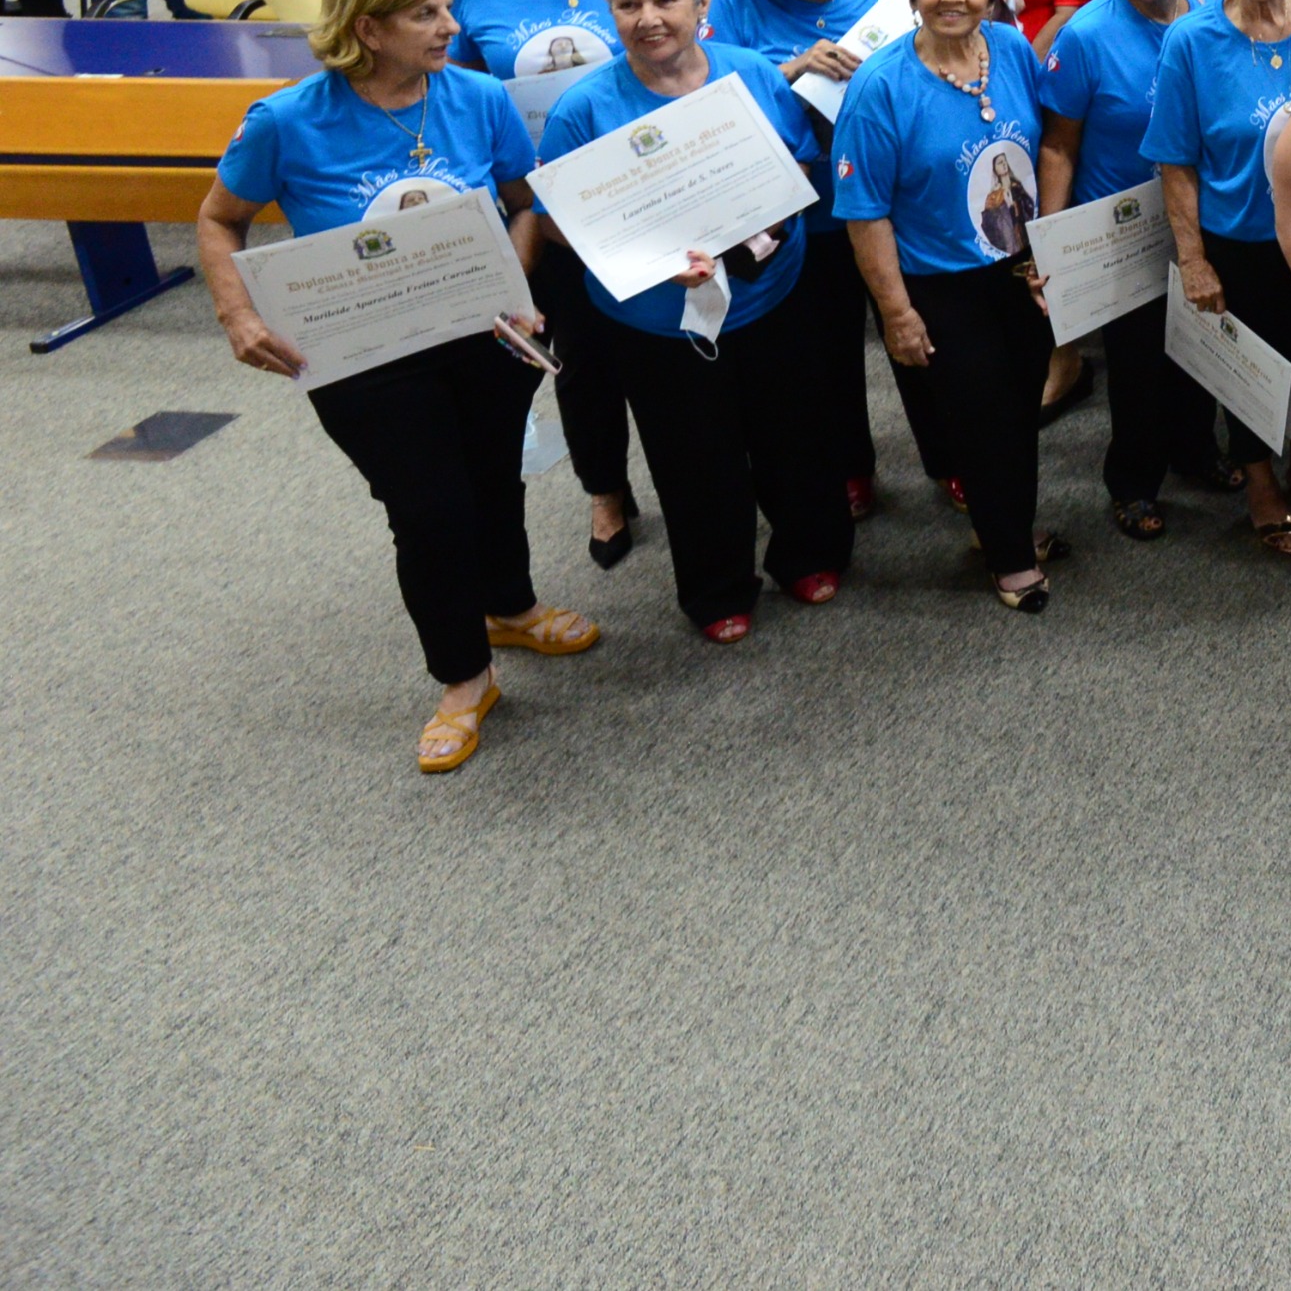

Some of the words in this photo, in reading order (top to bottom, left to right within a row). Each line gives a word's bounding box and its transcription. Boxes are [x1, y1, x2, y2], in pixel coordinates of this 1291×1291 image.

[1250, 96, 1286, 130] Mães
[578, 172, 629, 203] Diploma
[629, 164, 644, 179] de
[643, 147, 682, 170] Honra
[683, 140, 697, 153] ao
[699, 119, 737, 145] Mérito
[622, 196, 663, 222] Laurinha
[709, 160, 735, 178] Naves
[285, 272, 345, 294] Diploma
[348, 266, 362, 277] de
[364, 253, 409, 273] Honra
[412, 250, 427, 260] ao
[431, 233, 475, 254] Mérito
[354, 289, 404, 311] Aparecida
[442, 263, 488, 282] Carvalho
